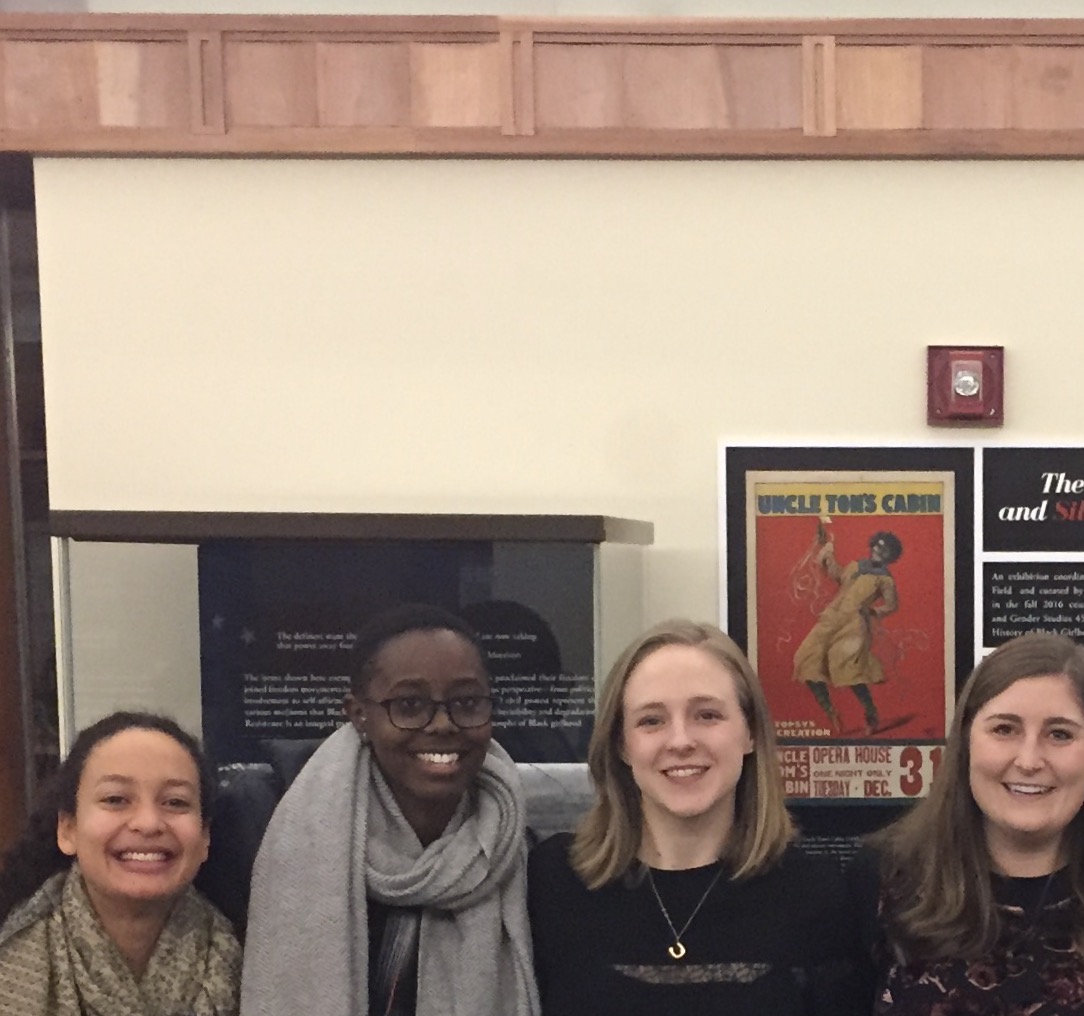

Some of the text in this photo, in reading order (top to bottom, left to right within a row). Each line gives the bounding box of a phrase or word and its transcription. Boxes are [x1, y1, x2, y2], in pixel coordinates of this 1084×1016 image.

[1041, 472, 1084, 493] The
[757, 494, 821, 514] UNCLE
[881, 494, 941, 514] CABIN
[998, 501, 1047, 522] and
[992, 572, 1003, 580] An
[1073, 586, 1083, 596] by
[1043, 600, 1064, 609] 2016
[1009, 614, 1040, 623] Gender
[992, 628, 1023, 638] History
[776, 728, 830, 736] CREATION
[813, 747, 892, 764] OPERA HOUSE
